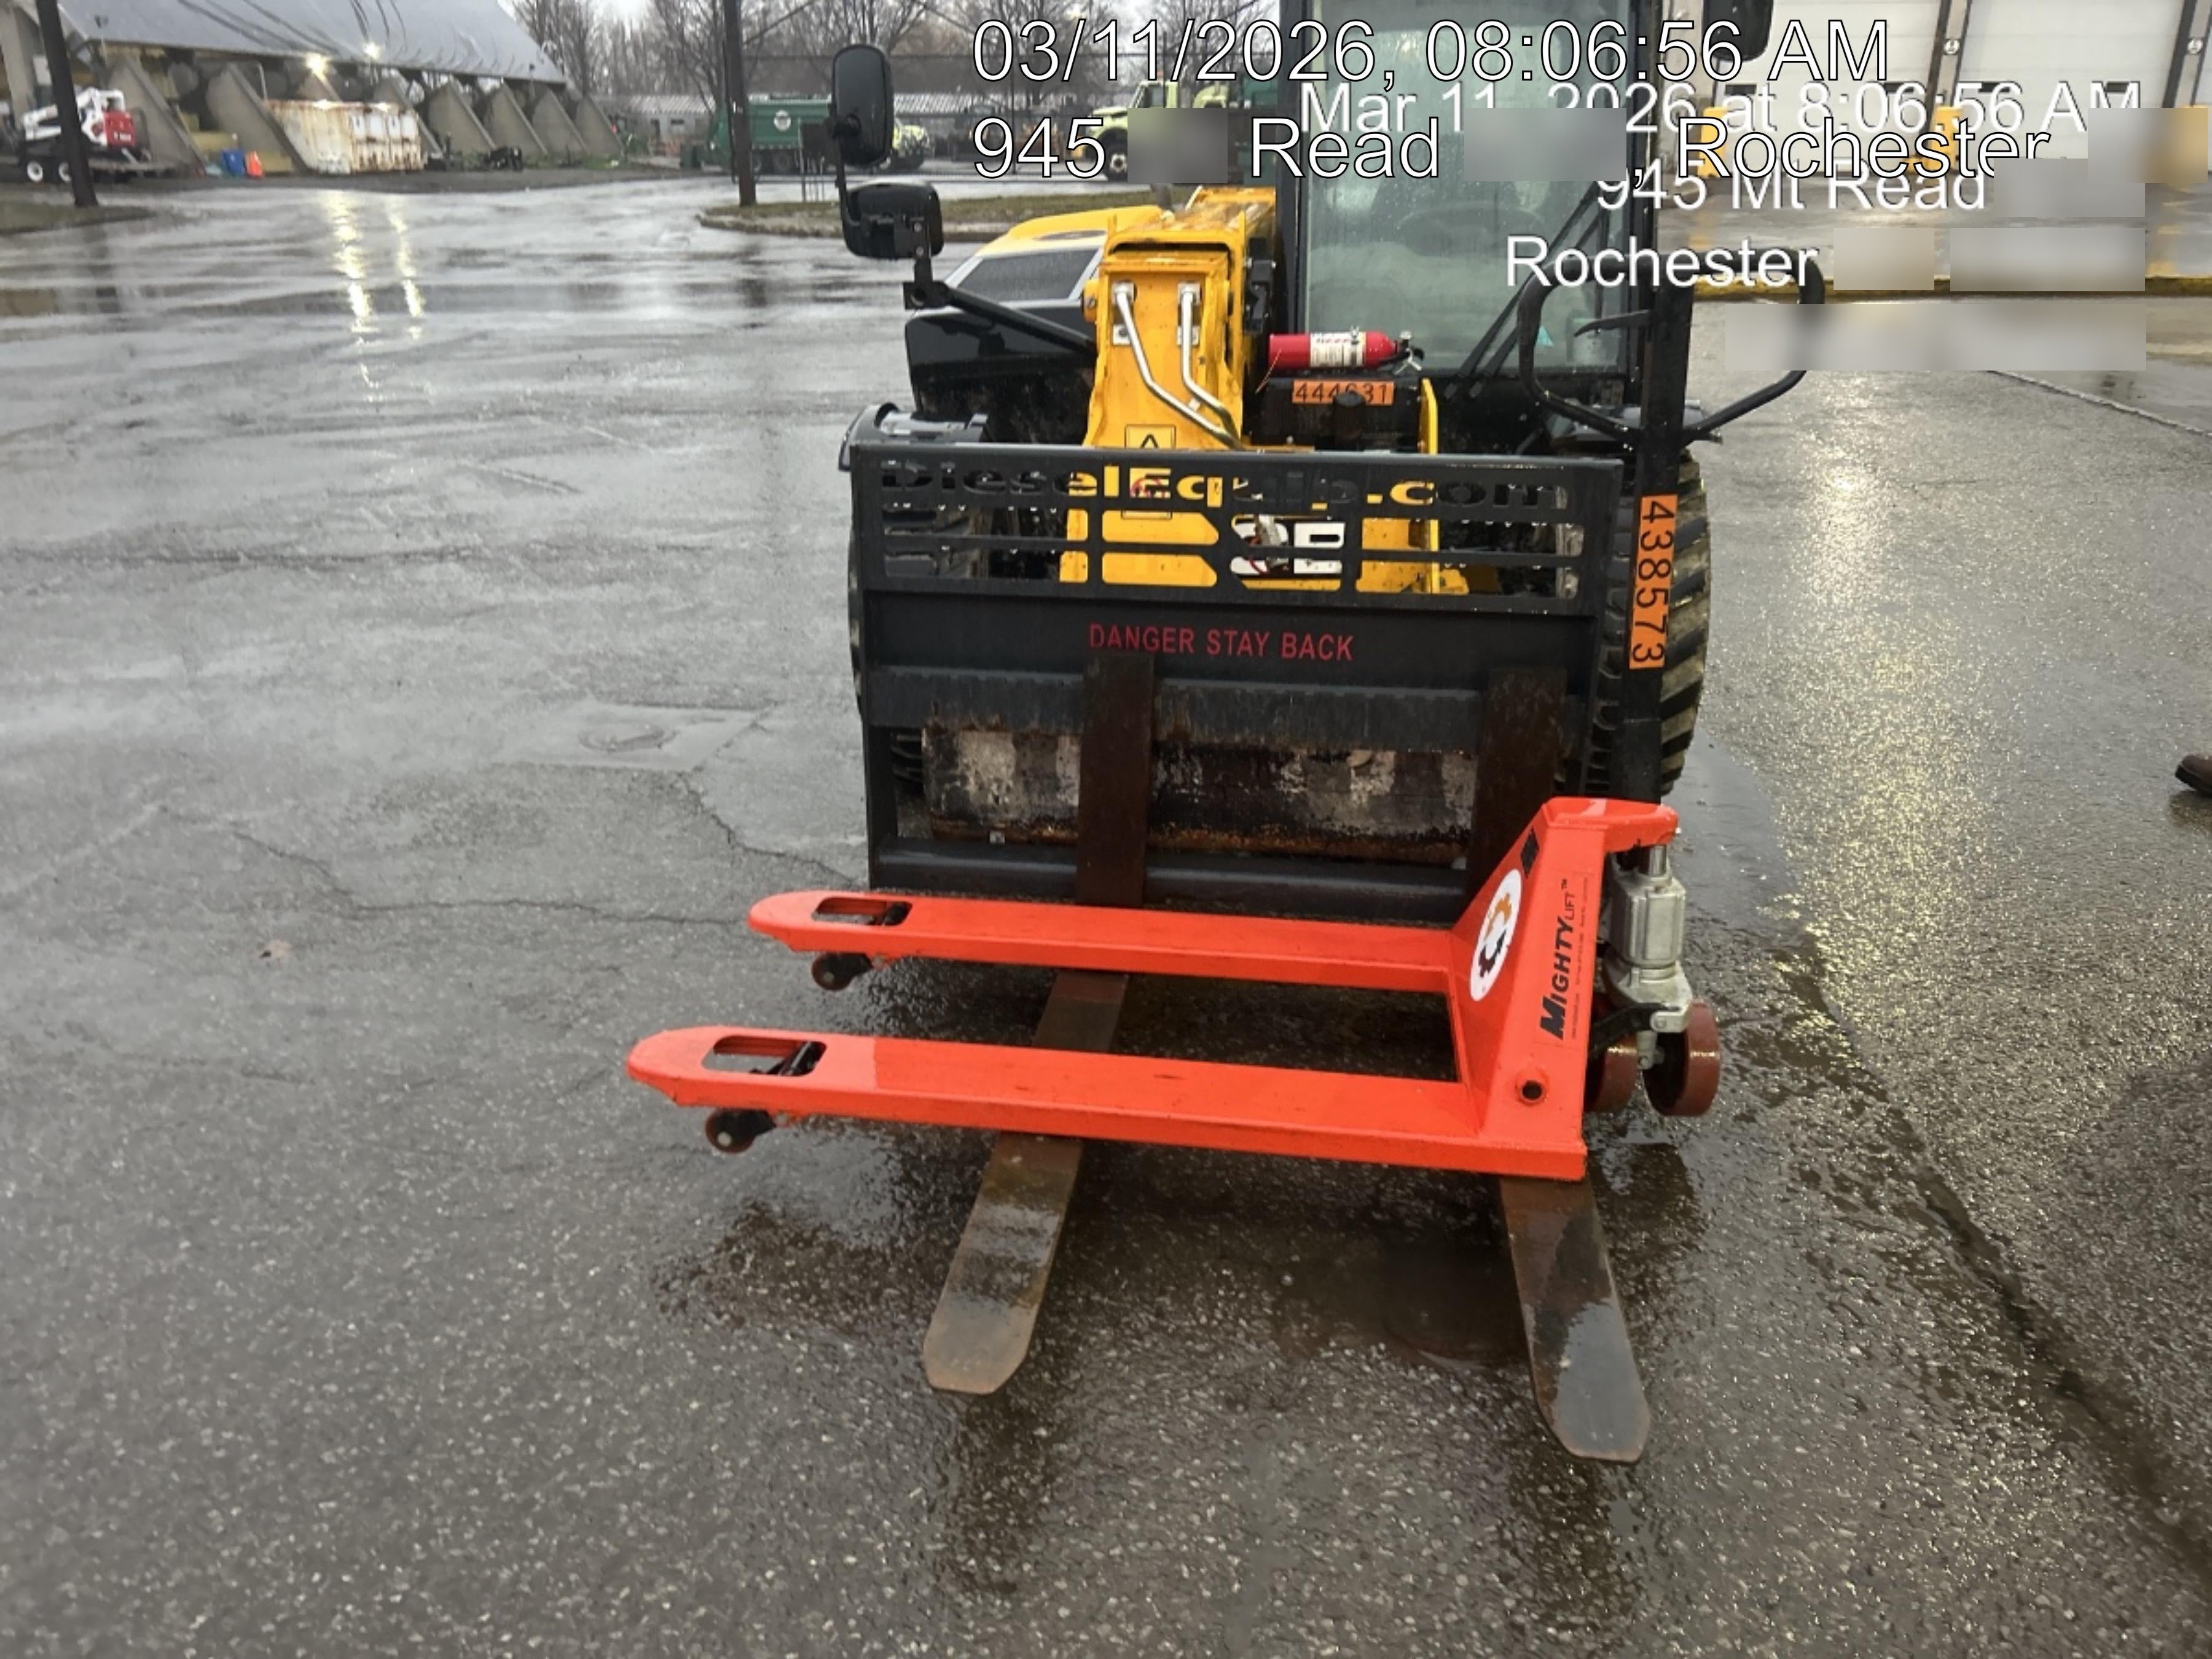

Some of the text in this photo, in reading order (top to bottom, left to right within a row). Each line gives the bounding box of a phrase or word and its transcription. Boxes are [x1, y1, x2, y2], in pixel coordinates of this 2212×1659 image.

[1631, 498, 1676, 664] 438573
[1089, 624, 1354, 661] DANGER STAY BACK
